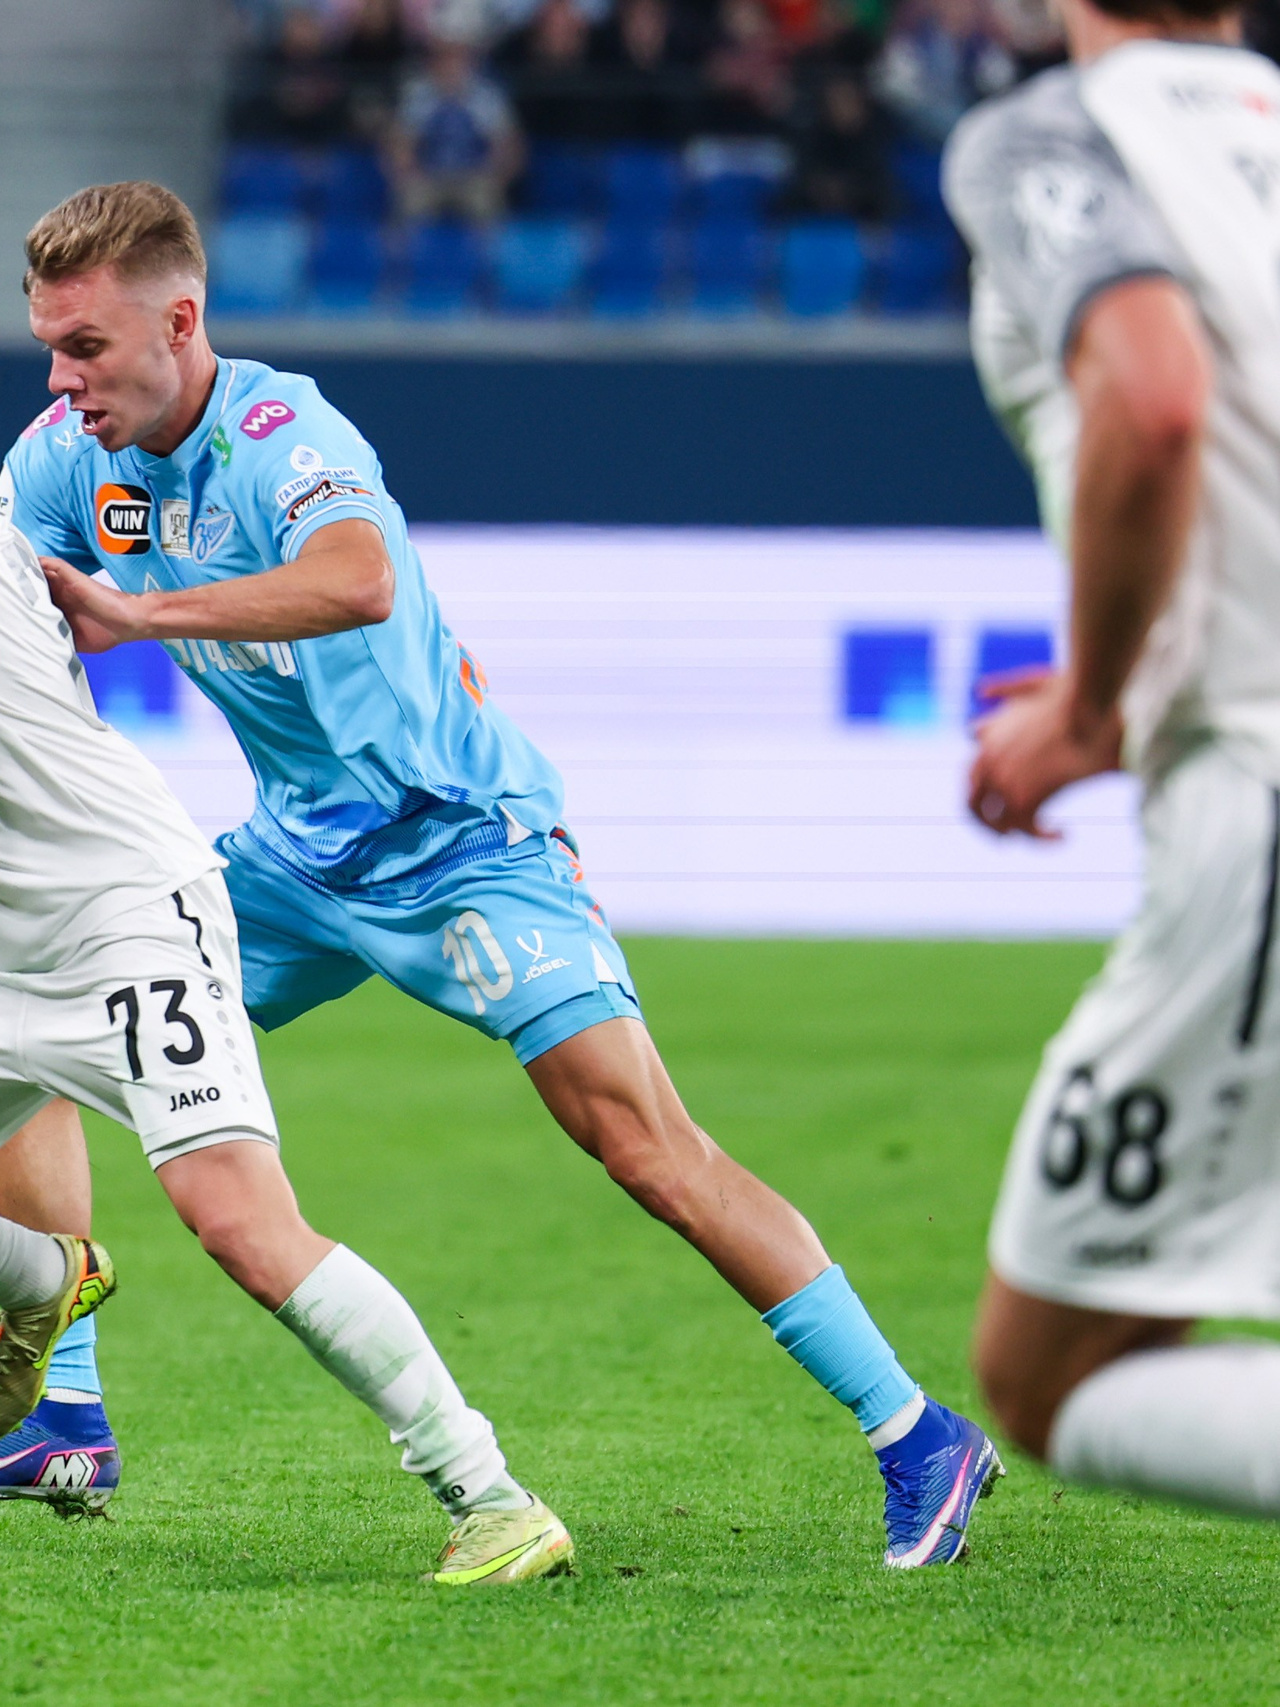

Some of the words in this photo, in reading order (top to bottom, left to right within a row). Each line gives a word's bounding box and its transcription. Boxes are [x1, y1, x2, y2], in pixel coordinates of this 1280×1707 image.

[243, 405, 289, 432] wb
[277, 468, 358, 504] ГАЗПРОМБАНК
[109, 508, 146, 531] WIN
[442, 910, 514, 1016] 10
[521, 957, 573, 985] JÖGEL
[105, 979, 205, 1081] 73
[170, 1086, 221, 1112] JAKO
[1041, 1063, 1170, 1208] 68
